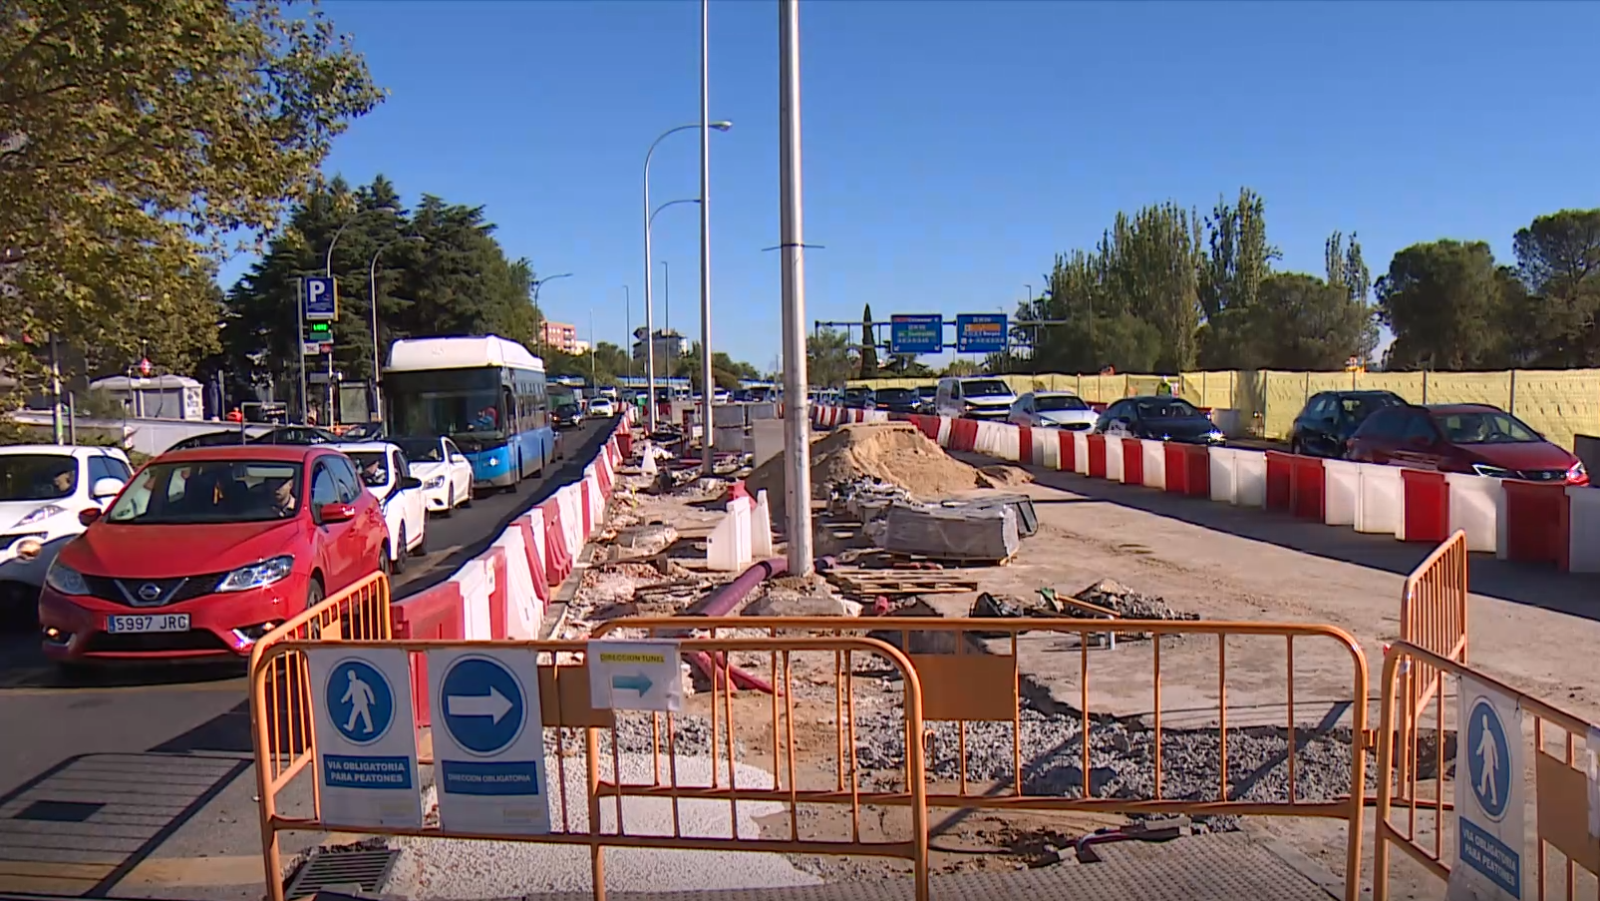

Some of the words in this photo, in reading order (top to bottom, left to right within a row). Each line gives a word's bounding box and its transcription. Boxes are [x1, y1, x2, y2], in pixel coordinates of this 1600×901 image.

[309, 280, 325, 303] P
[116, 616, 153, 631] 5997
[160, 615, 187, 630] JRG
[642, 655, 665, 663] TUNEL
[327, 761, 342, 770] VIA
[343, 761, 405, 772] OBLIGATORIA
[331, 771, 353, 781] PARA
[354, 773, 403, 783] PEATONES
[483, 773, 531, 782] OBLIGATORIA
[1463, 828, 1475, 843] VIA
[1475, 834, 1516, 873] OBLIGATORIA
[1464, 842, 1481, 862] PARA
[1481, 854, 1516, 887] PEATONES
